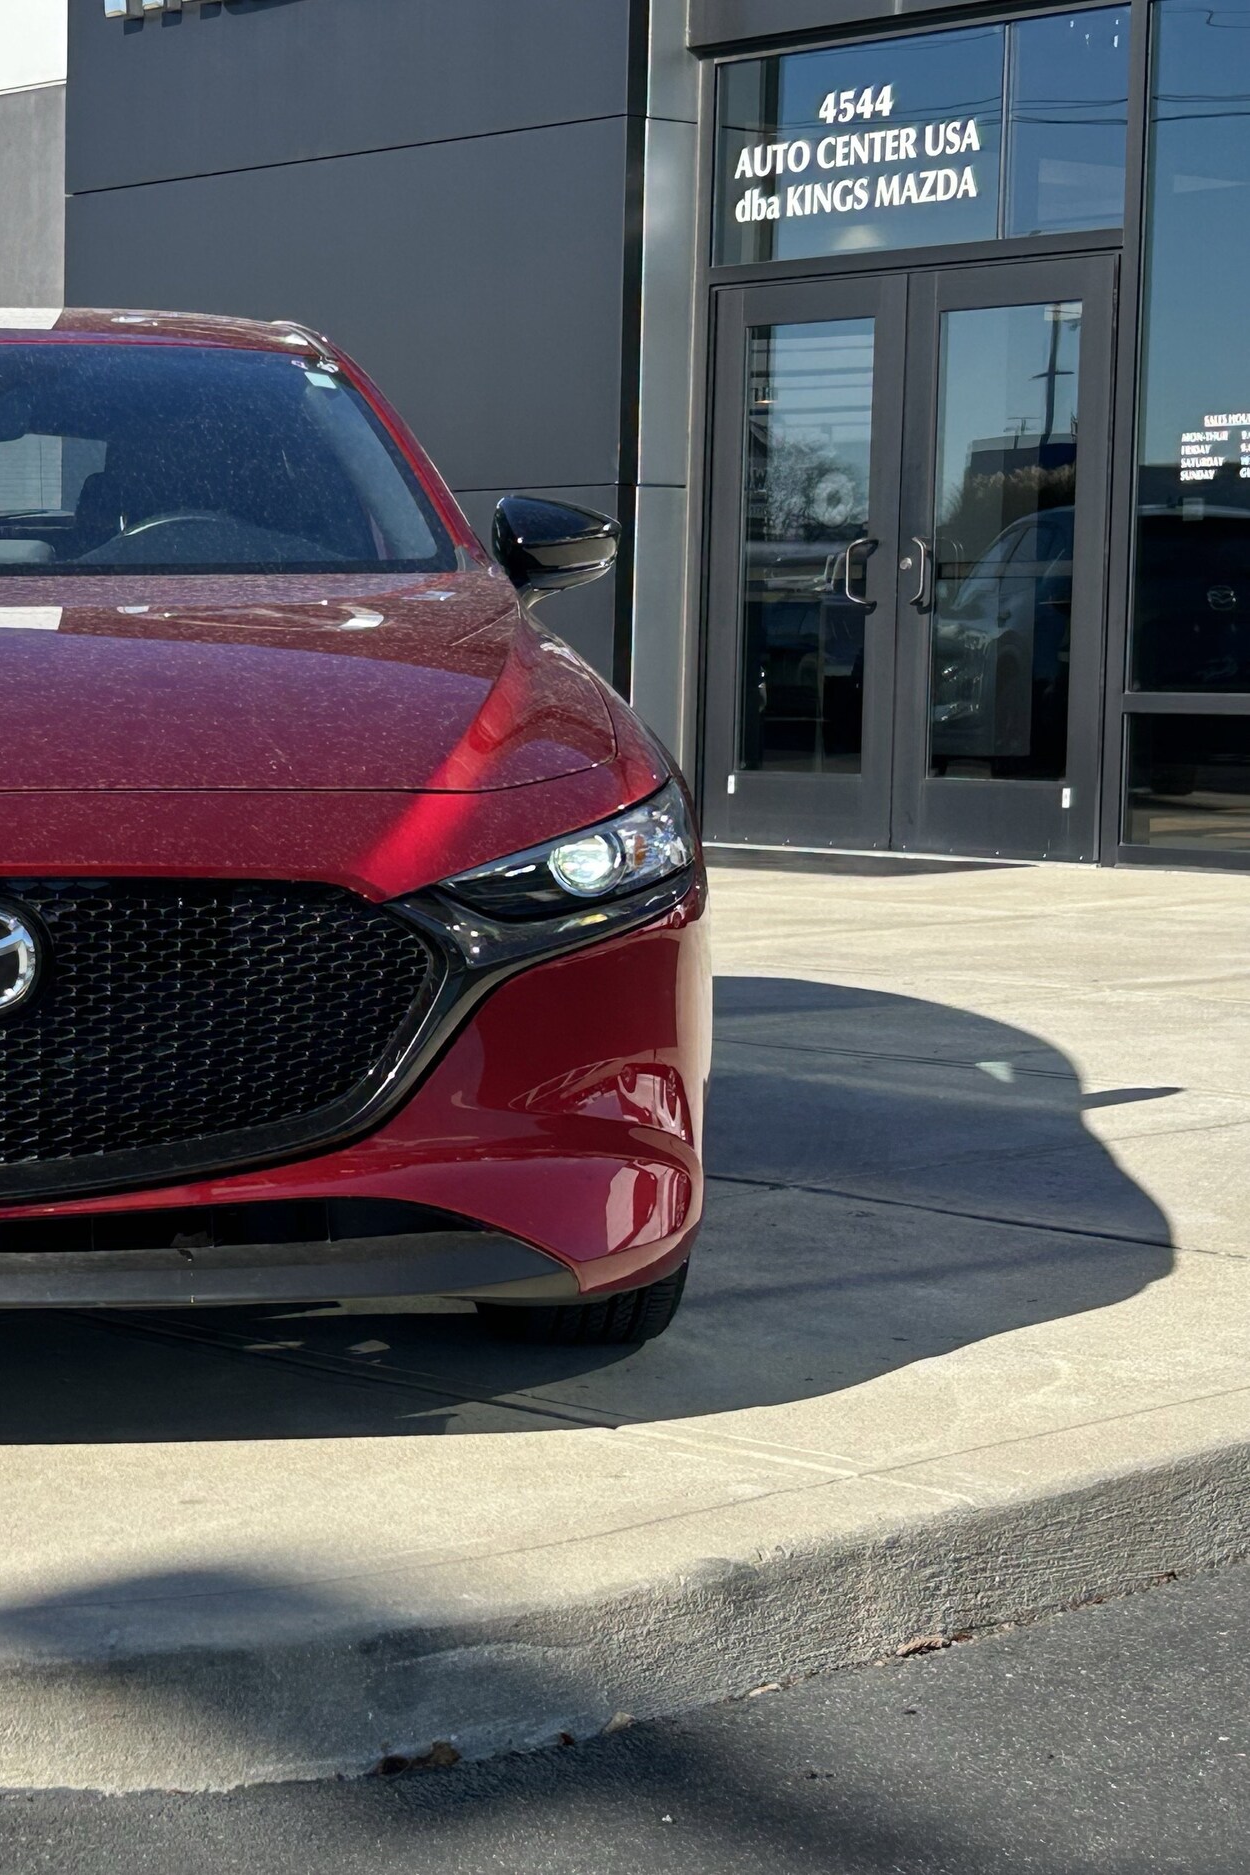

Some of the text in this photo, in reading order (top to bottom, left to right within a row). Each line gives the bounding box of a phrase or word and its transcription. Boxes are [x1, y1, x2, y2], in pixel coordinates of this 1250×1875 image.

[818, 84, 894, 124] 4544
[734, 117, 980, 179] AUTO CENTER USA
[735, 164, 978, 222] dba KINGS MAZDA
[1180, 444, 1211, 455] FRIDAY
[1180, 456, 1225, 468] SATURDAY
[1180, 469, 1215, 481] SUNDAY
